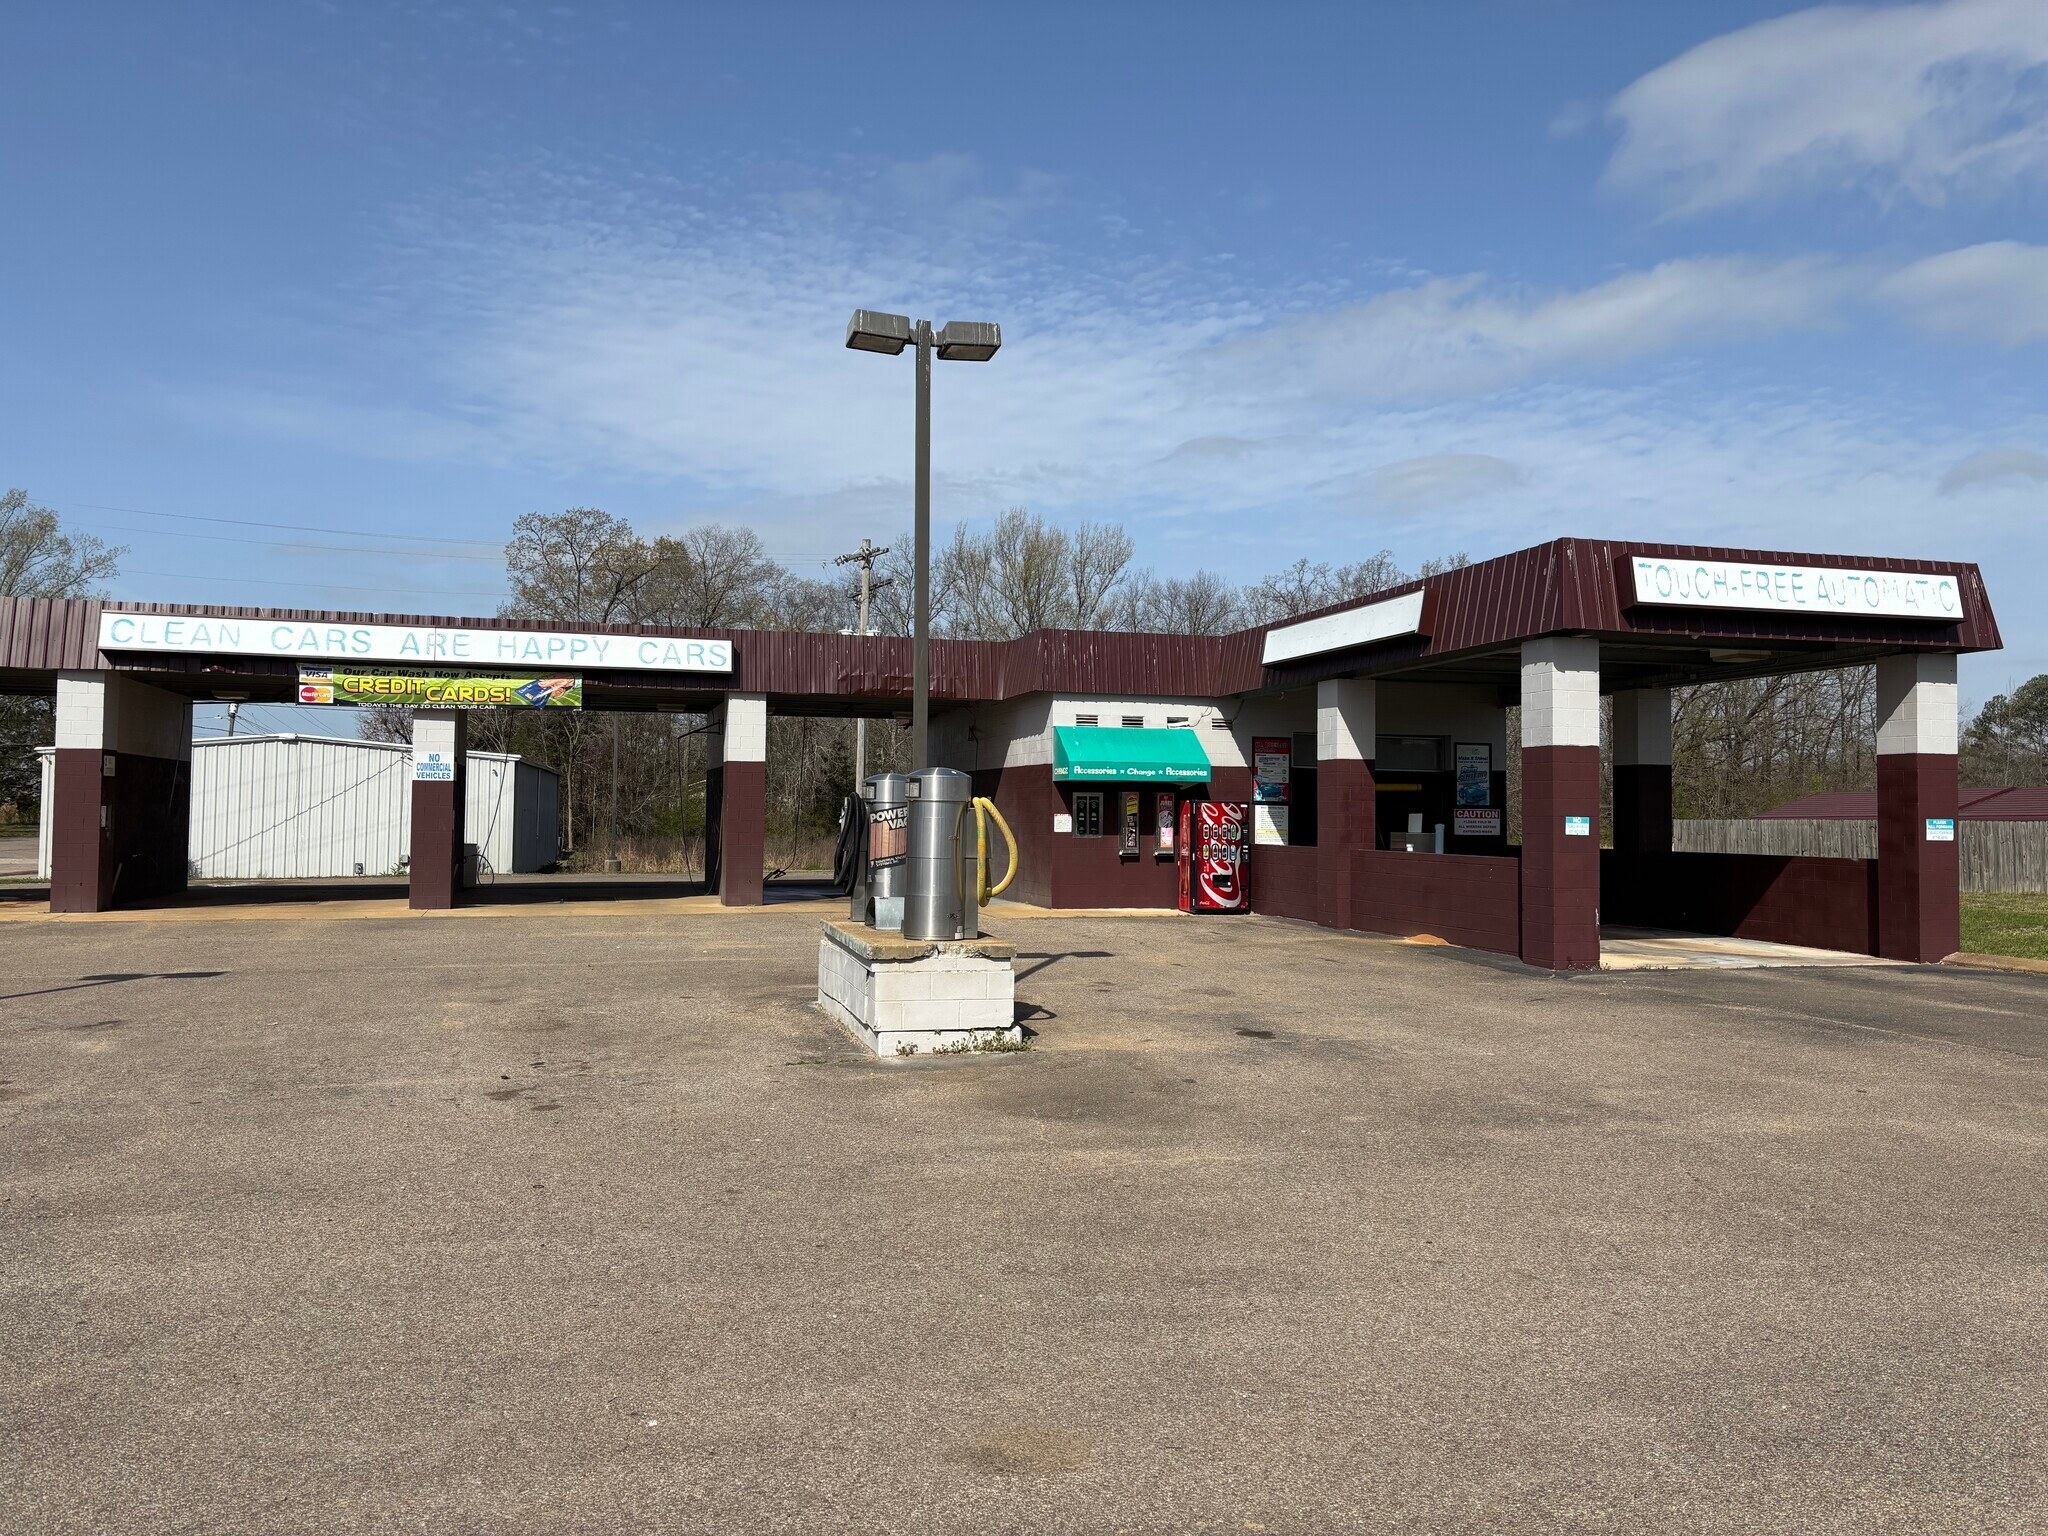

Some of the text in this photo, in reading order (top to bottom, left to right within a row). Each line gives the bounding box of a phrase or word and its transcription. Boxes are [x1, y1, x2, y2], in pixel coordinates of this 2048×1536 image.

[1637, 562, 1806, 604] TOUCH-FREE
[110, 618, 728, 667] CLEAN CARS ARE HAPPY CARS
[343, 667, 512, 681] Our Car Wash Now Accepts
[342, 677, 425, 695] CREDIT
[425, 685, 512, 703] CARDS!
[429, 754, 440, 762] NO
[416, 763, 451, 772] COMMERCIAL
[1073, 765, 1208, 777] Accessories Change Accessories
[1457, 810, 1498, 818] CAUTION
